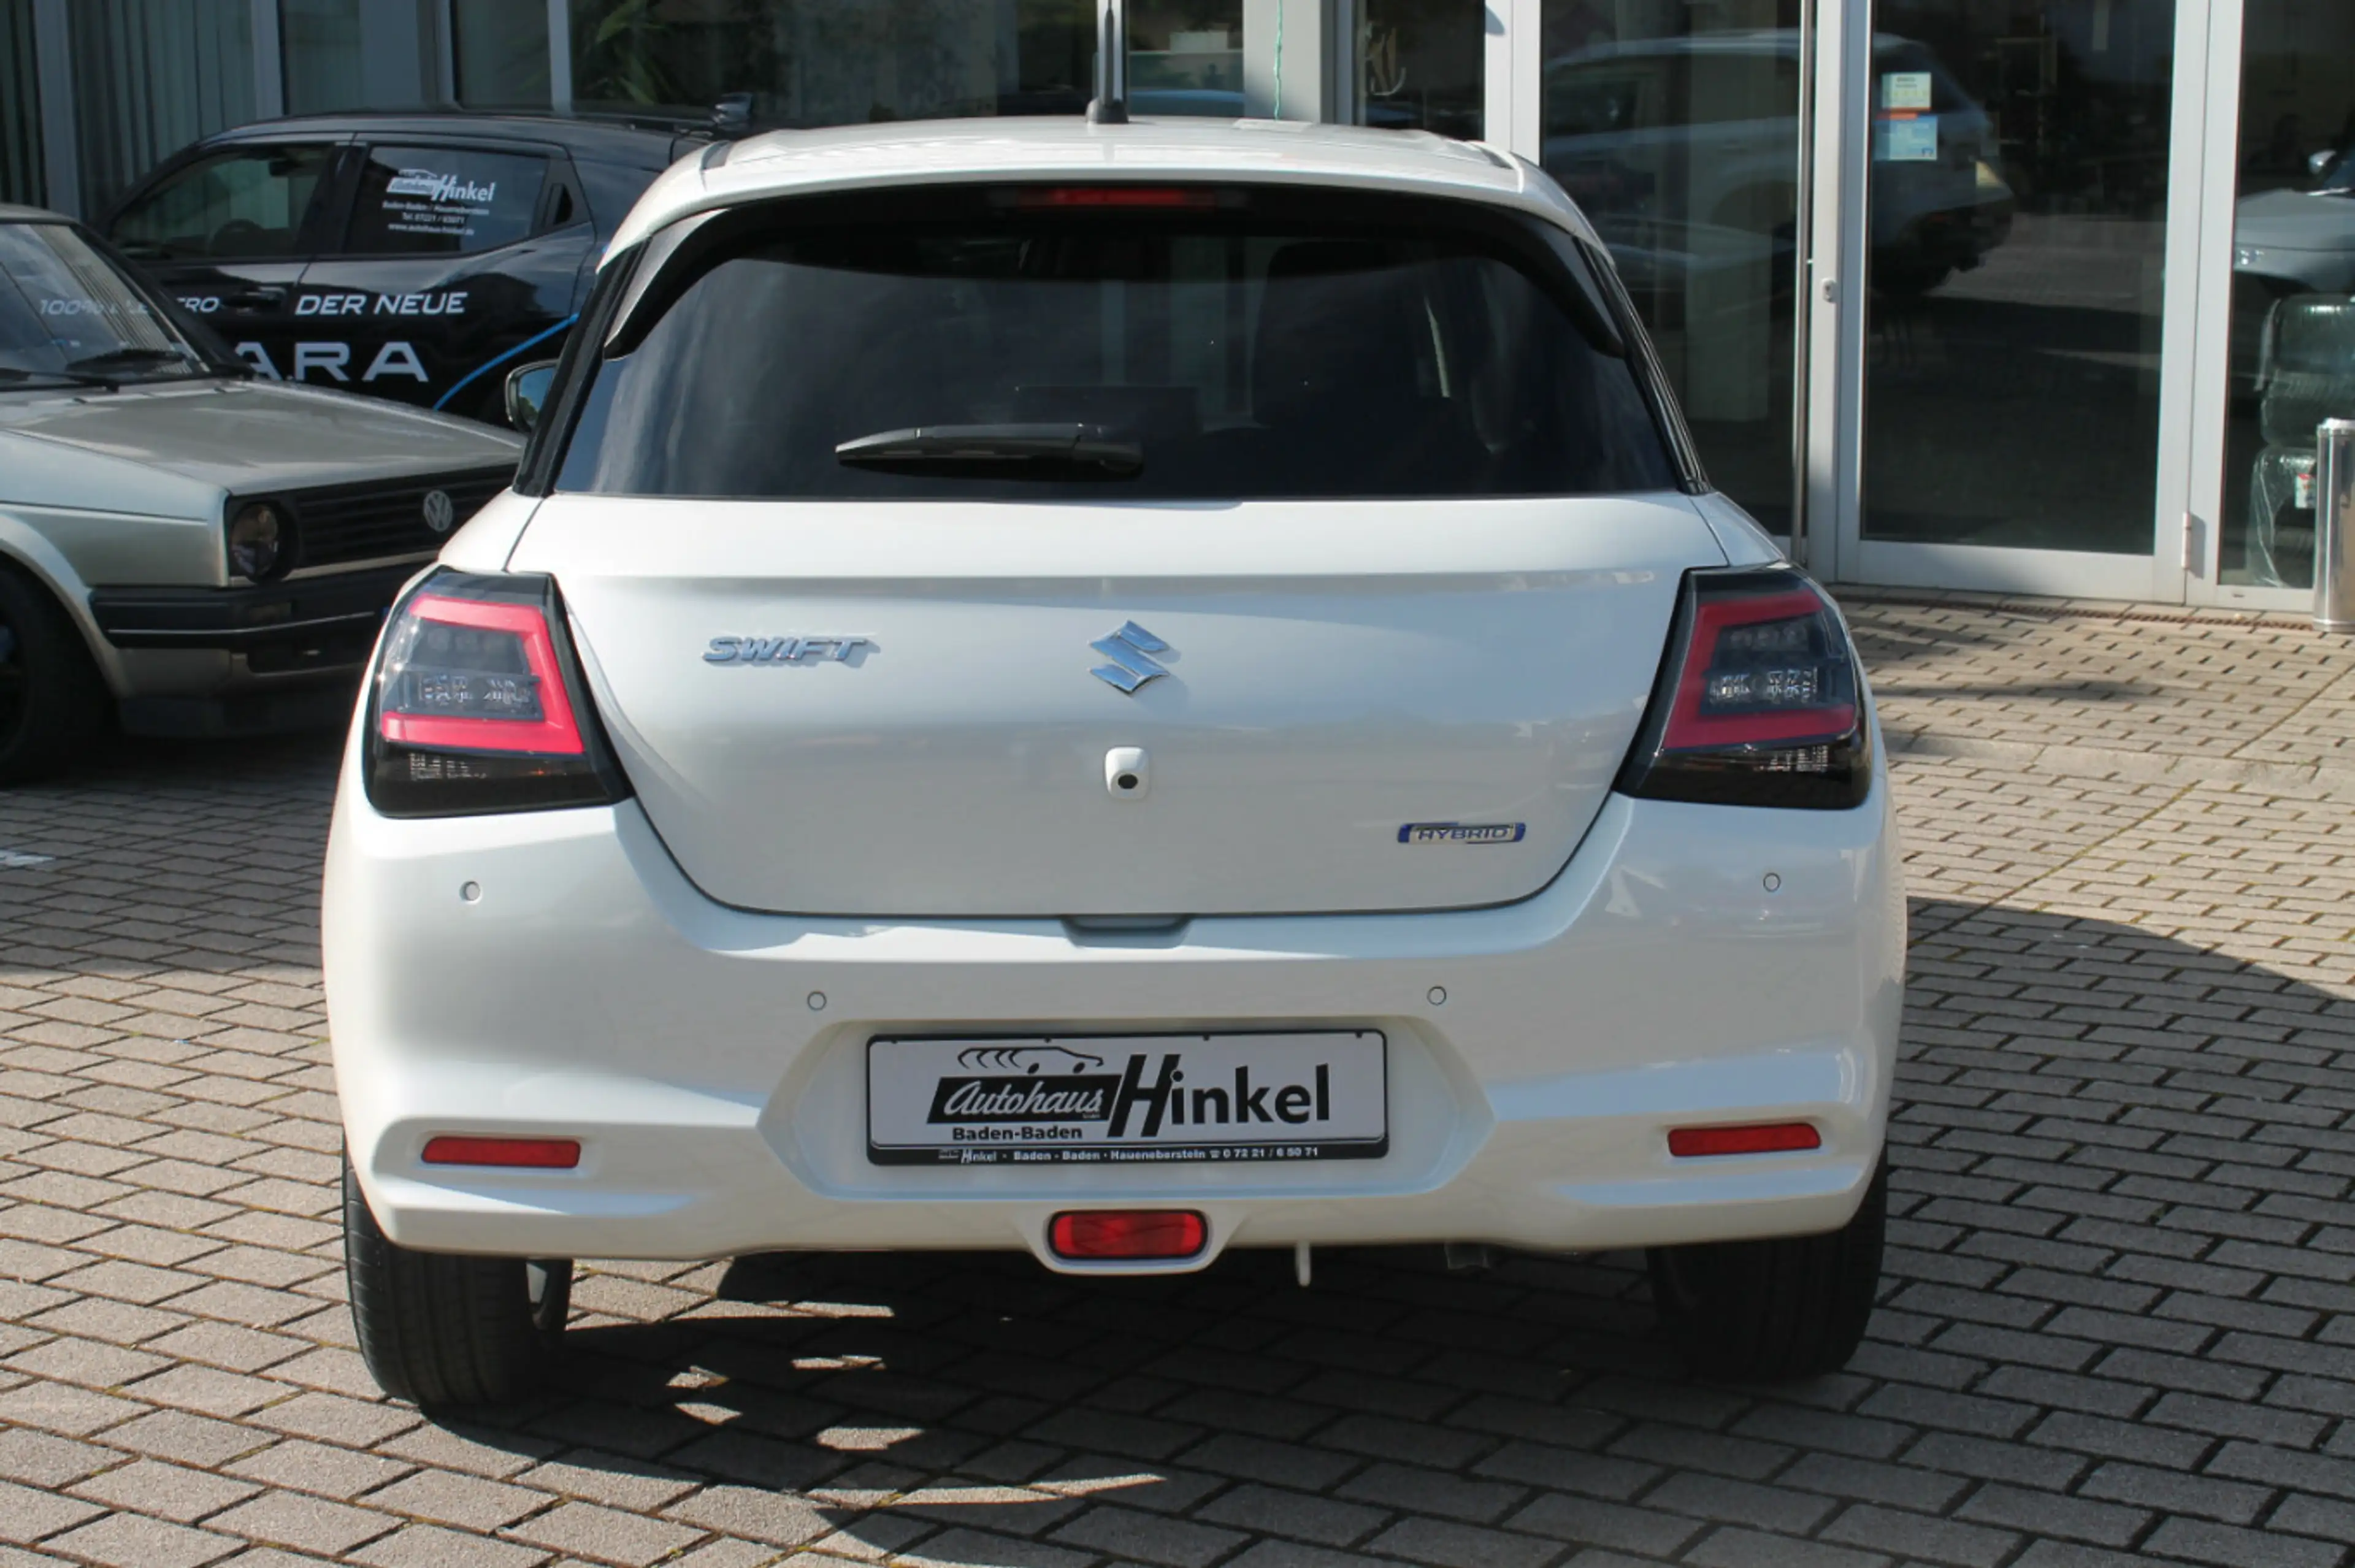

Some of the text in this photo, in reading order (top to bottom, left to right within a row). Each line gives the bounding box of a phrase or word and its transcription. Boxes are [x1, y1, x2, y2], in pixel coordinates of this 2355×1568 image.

[431, 174, 496, 202] Hinkel
[295, 292, 468, 315] DER NEUE
[702, 635, 869, 662] SWIFT
[1417, 827, 1509, 841] HYBRID
[943, 1054, 1330, 1138] Autohaus Hinkel
[952, 1126, 1082, 1141] Baden-Baden
[1013, 1150, 1052, 1161] Baden
[1062, 1150, 1100, 1160] Baden
